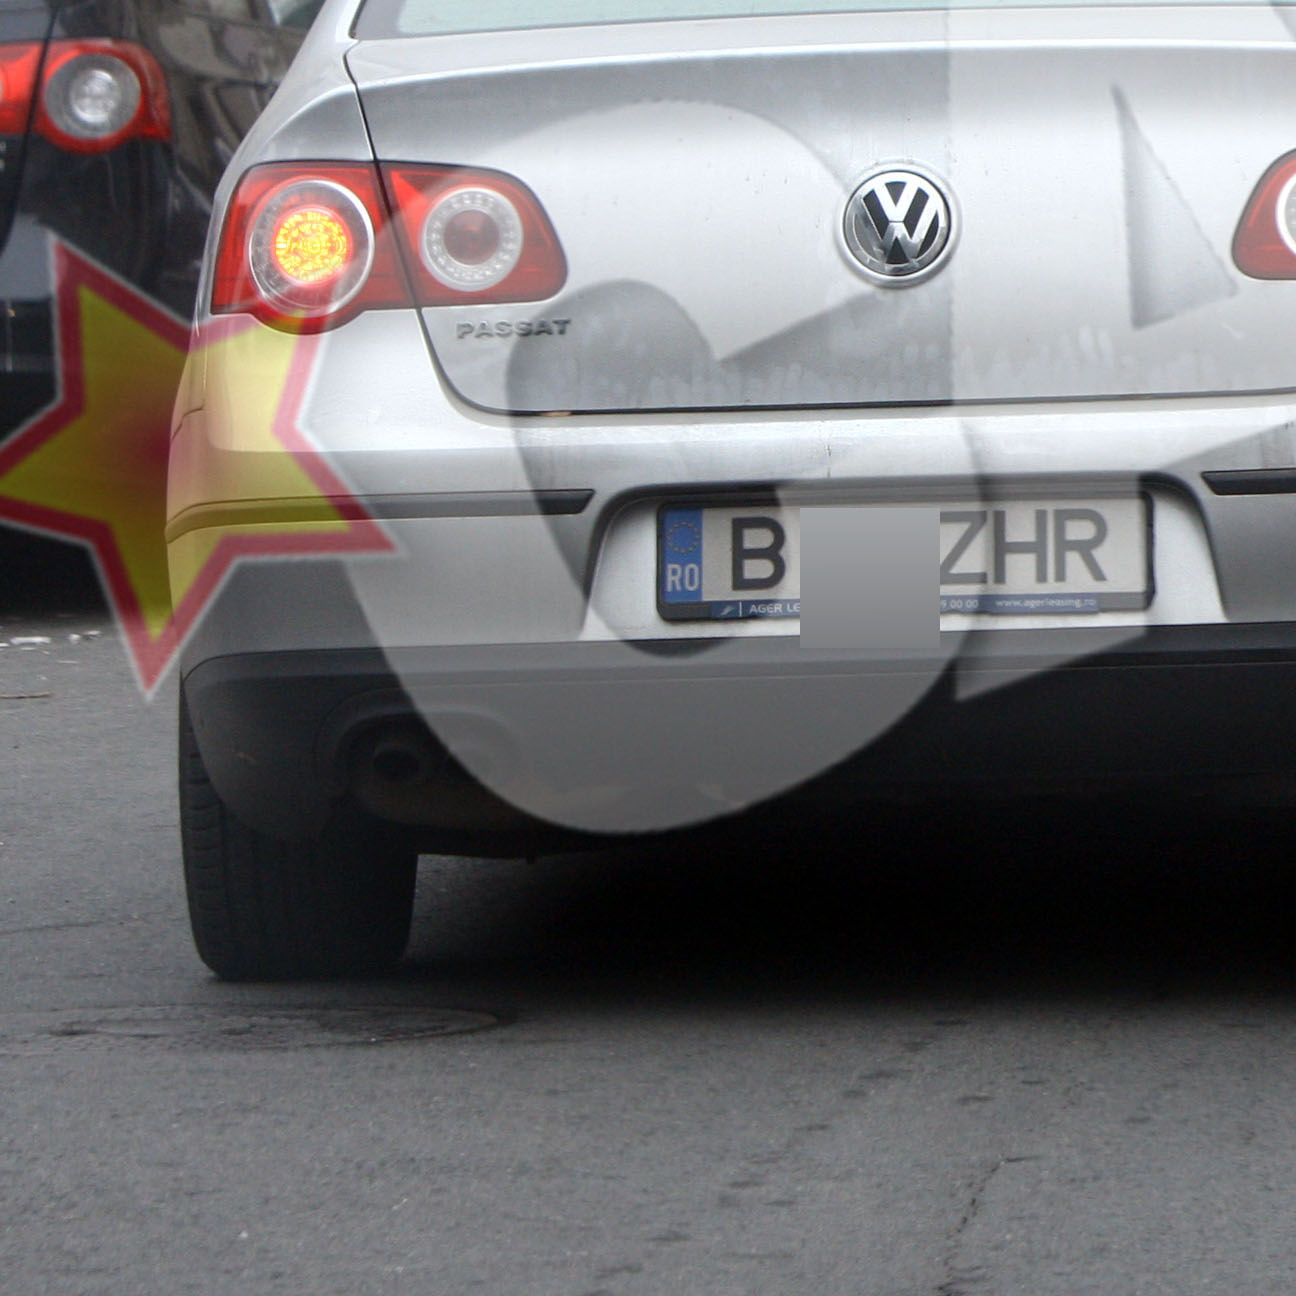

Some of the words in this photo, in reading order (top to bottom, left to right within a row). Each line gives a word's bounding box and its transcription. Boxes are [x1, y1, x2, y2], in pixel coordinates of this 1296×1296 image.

[456, 318, 571, 339] PASSAT
[664, 561, 700, 593] RO
[749, 603, 783, 615] AGER
